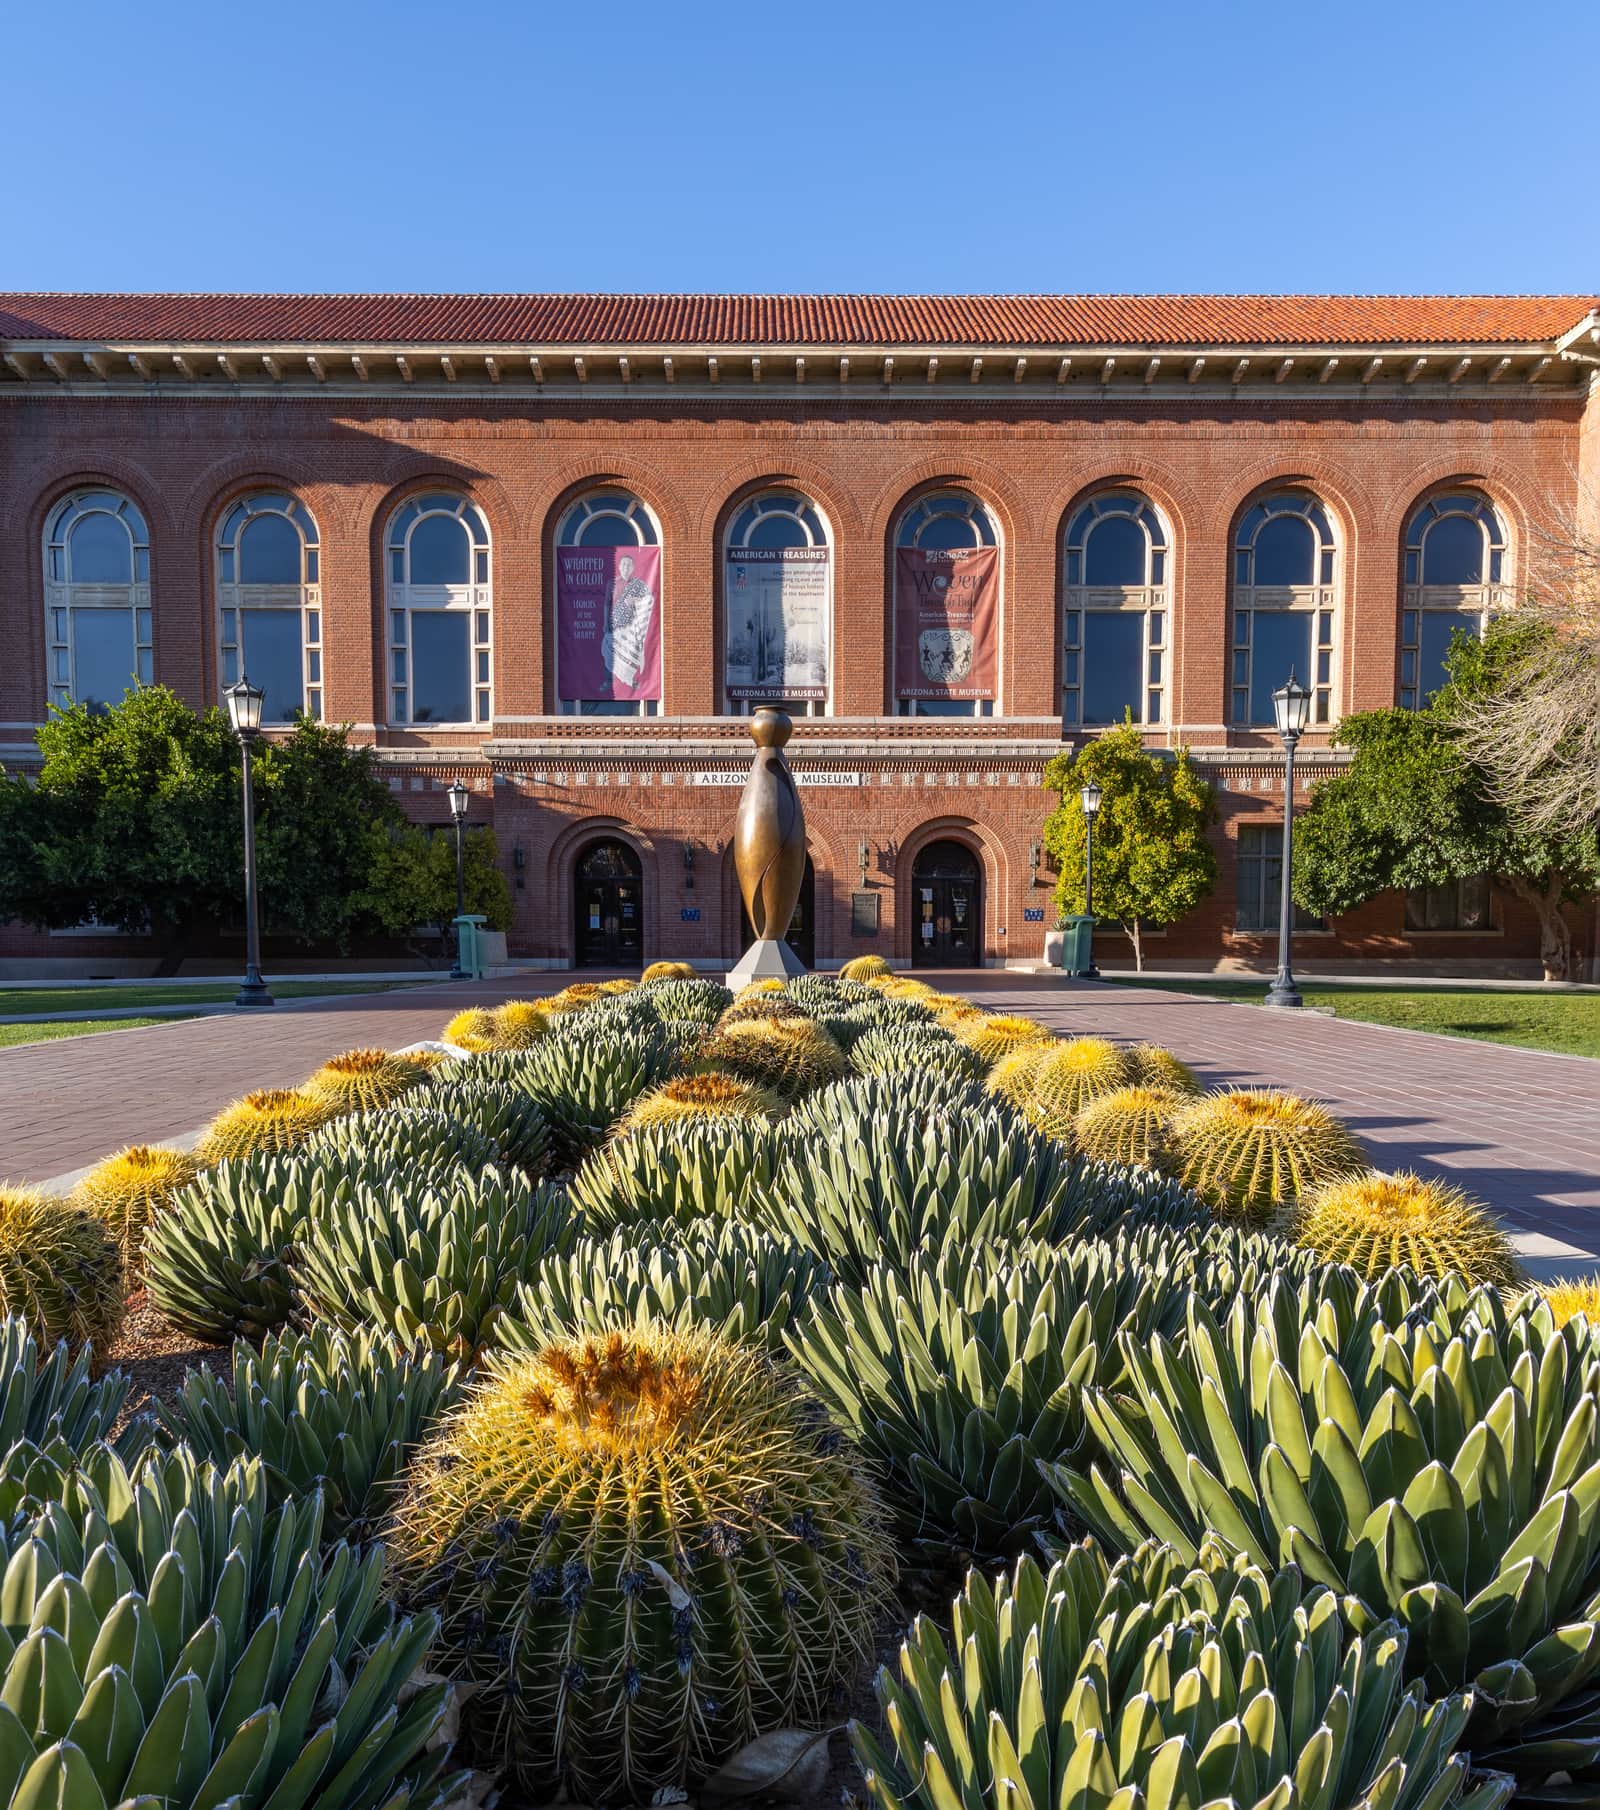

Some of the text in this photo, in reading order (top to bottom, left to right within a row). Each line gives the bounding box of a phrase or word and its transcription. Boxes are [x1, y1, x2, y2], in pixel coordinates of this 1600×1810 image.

[730, 551, 826, 559] AMERICAN TREASURES
[938, 551, 968, 559] OneAZ
[564, 557, 603, 570] WRAPPED
[566, 572, 603, 585] IN COLOR
[912, 571, 983, 593] Woven
[731, 689, 825, 697] ARIZONA STATE MUSEUM
[900, 688, 992, 696] ARIZONA STATE MUSEUM
[702, 773, 748, 784] ARIZON
[801, 773, 853, 784] MUSEUM
